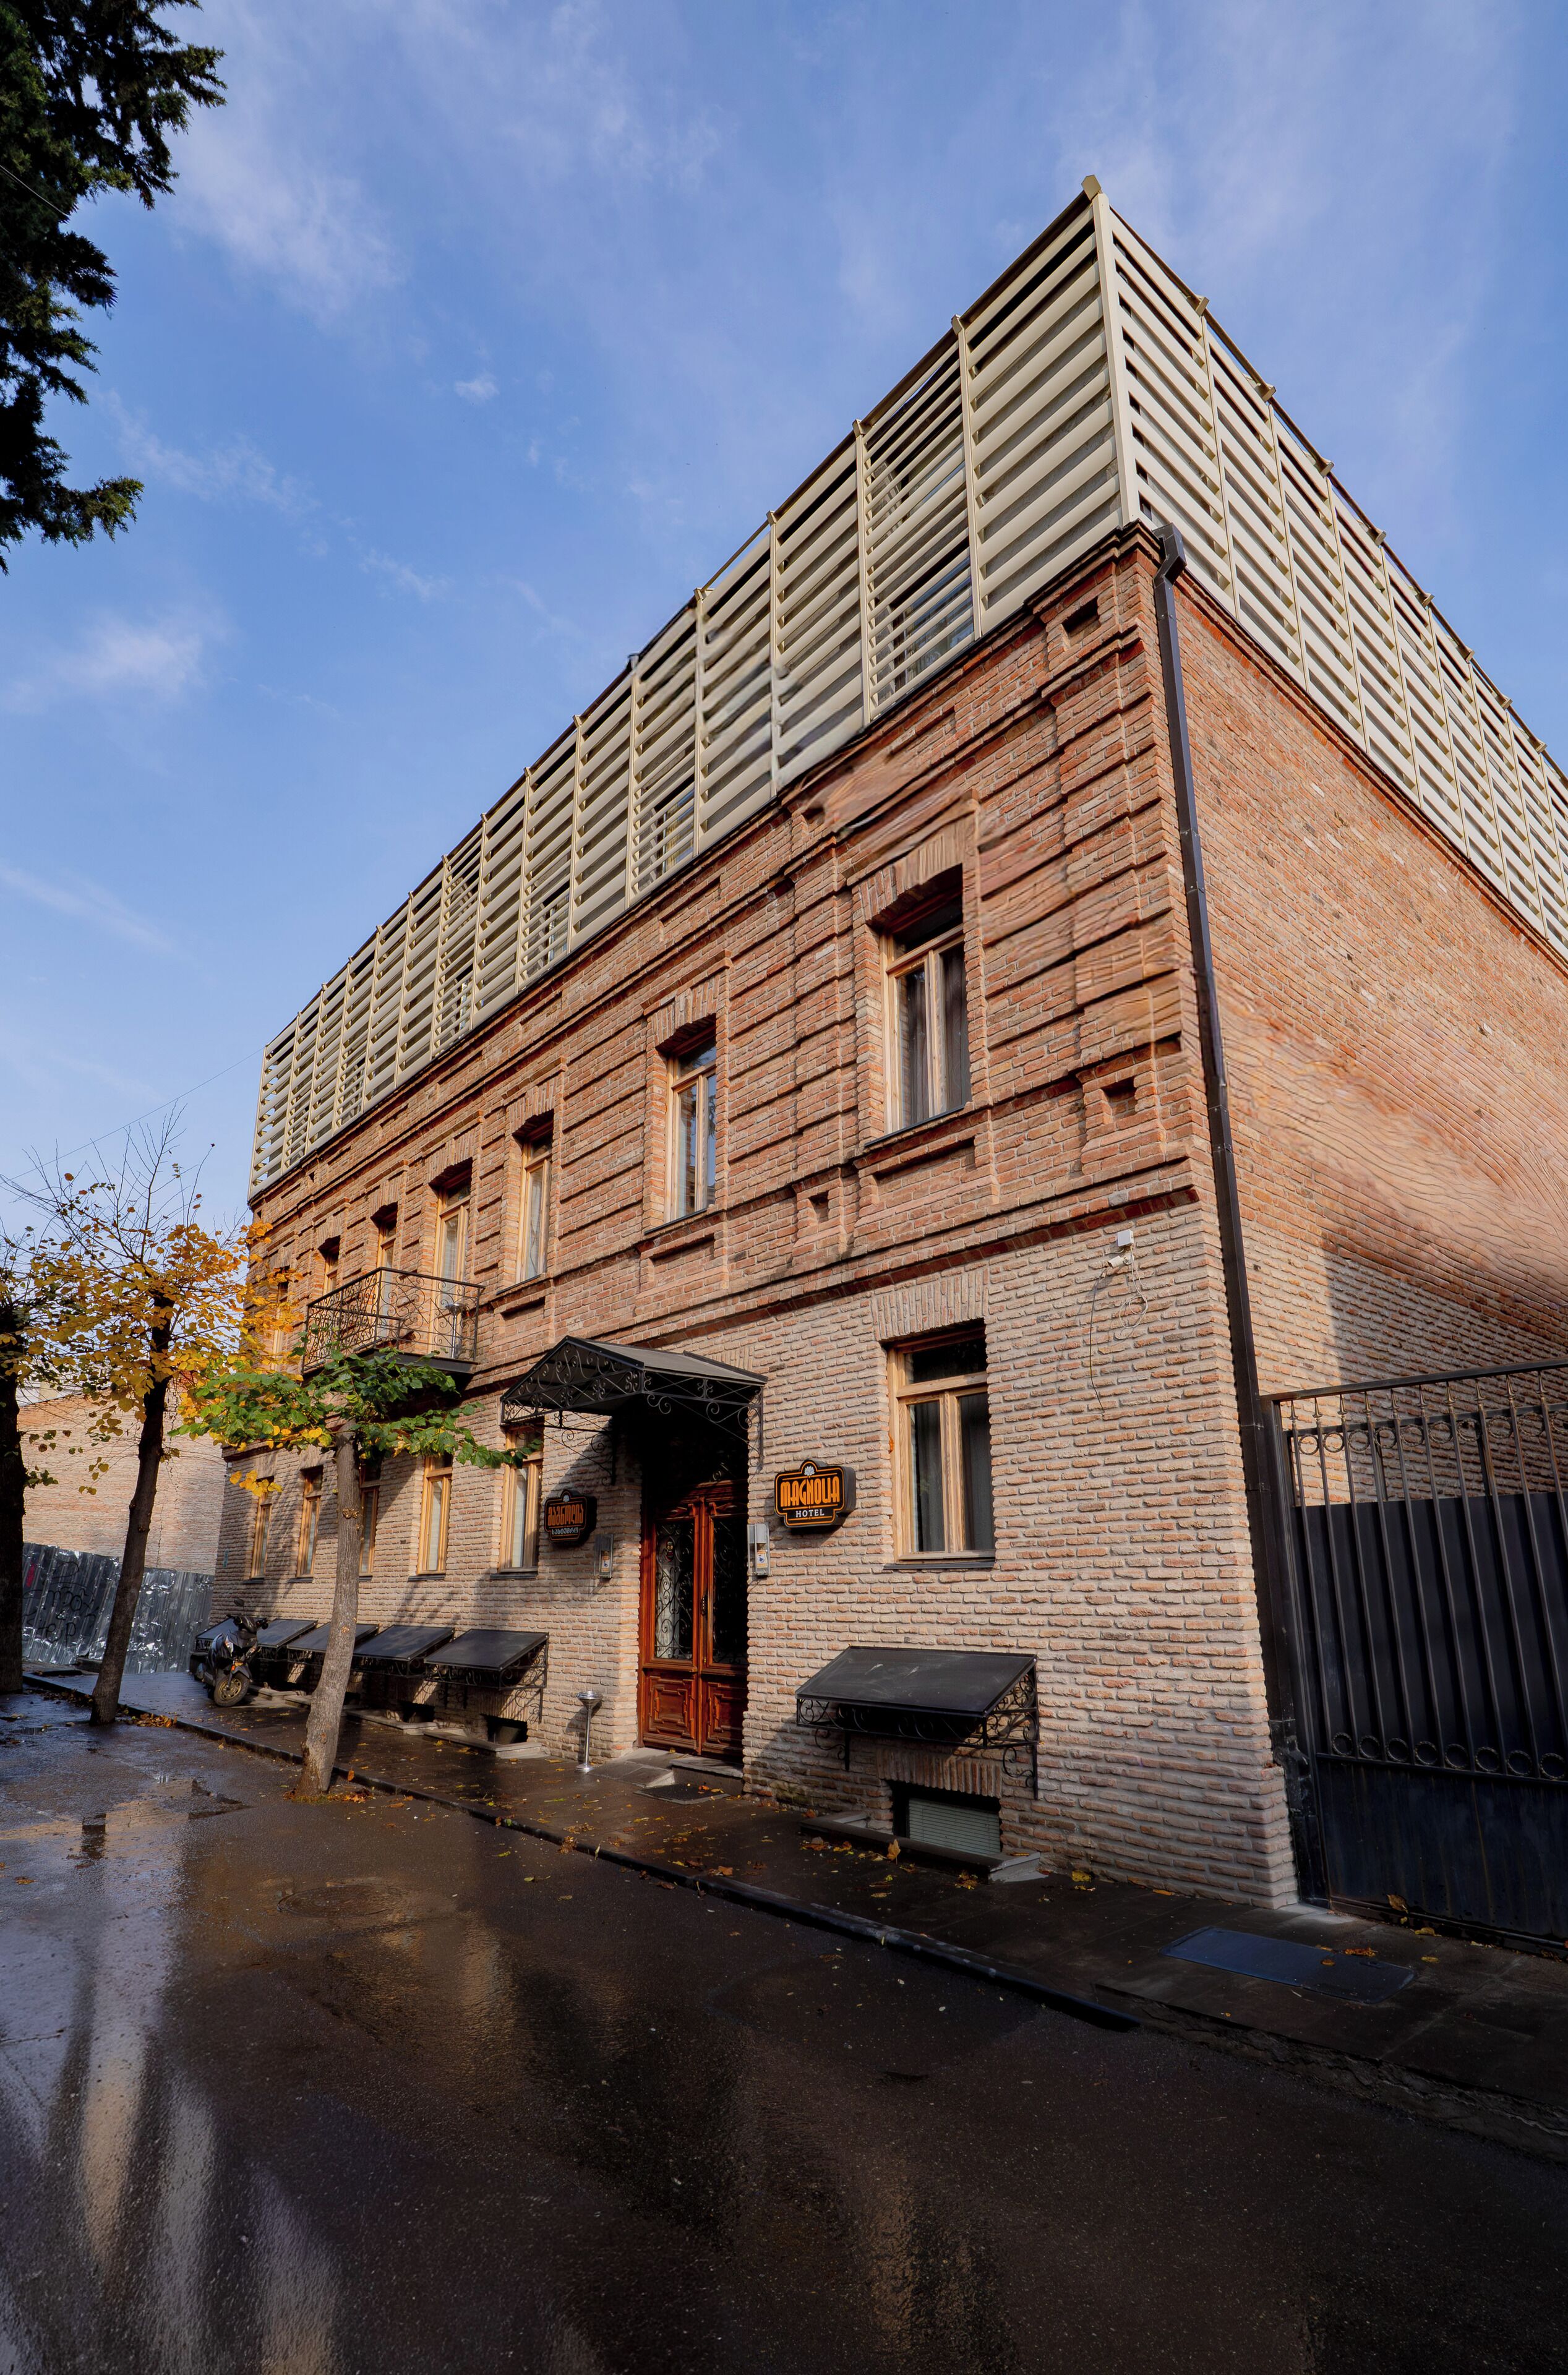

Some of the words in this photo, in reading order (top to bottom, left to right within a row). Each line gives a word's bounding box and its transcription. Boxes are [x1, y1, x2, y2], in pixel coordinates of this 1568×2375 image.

[781, 1476, 840, 1507] MAGNOLIA
[548, 1504, 583, 1526] მაგნოლია
[795, 1509, 825, 1517] HOTEL
